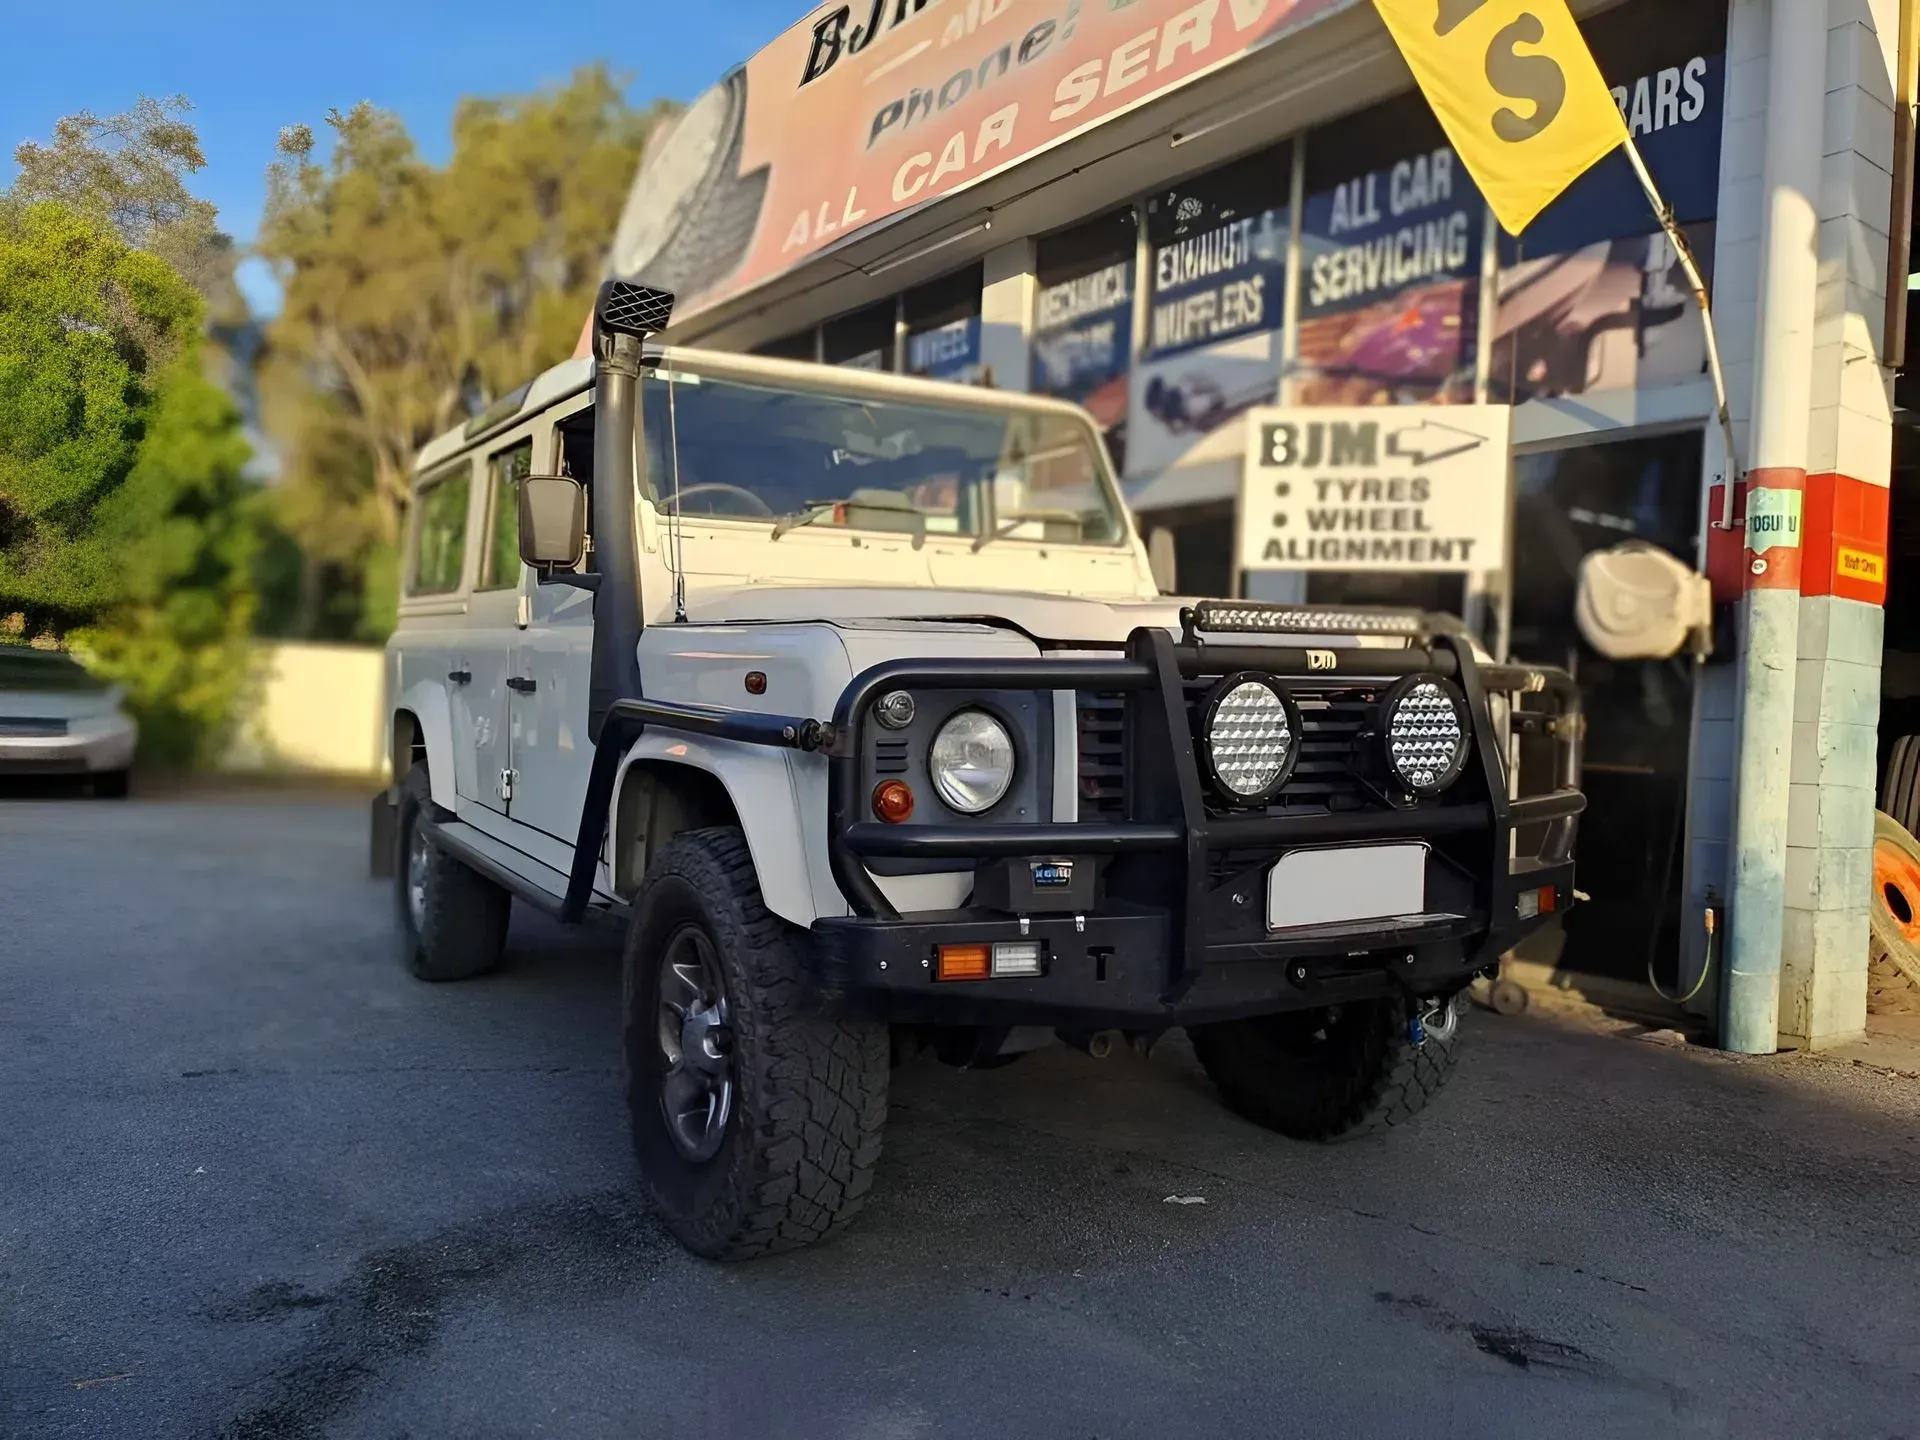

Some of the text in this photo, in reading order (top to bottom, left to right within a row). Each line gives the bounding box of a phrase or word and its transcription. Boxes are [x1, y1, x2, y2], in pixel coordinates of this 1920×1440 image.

[782, 186, 867, 254] ALL
[892, 102, 1019, 202] CAR
[1329, 147, 1453, 236] ALL CAR
[1309, 210, 1468, 306] SERVICING
[1259, 421, 1379, 468] BJM
[1313, 477, 1431, 502] TYRES
[1306, 507, 1432, 532] WHEEL
[1261, 537, 1477, 562] ALIGNMENT
